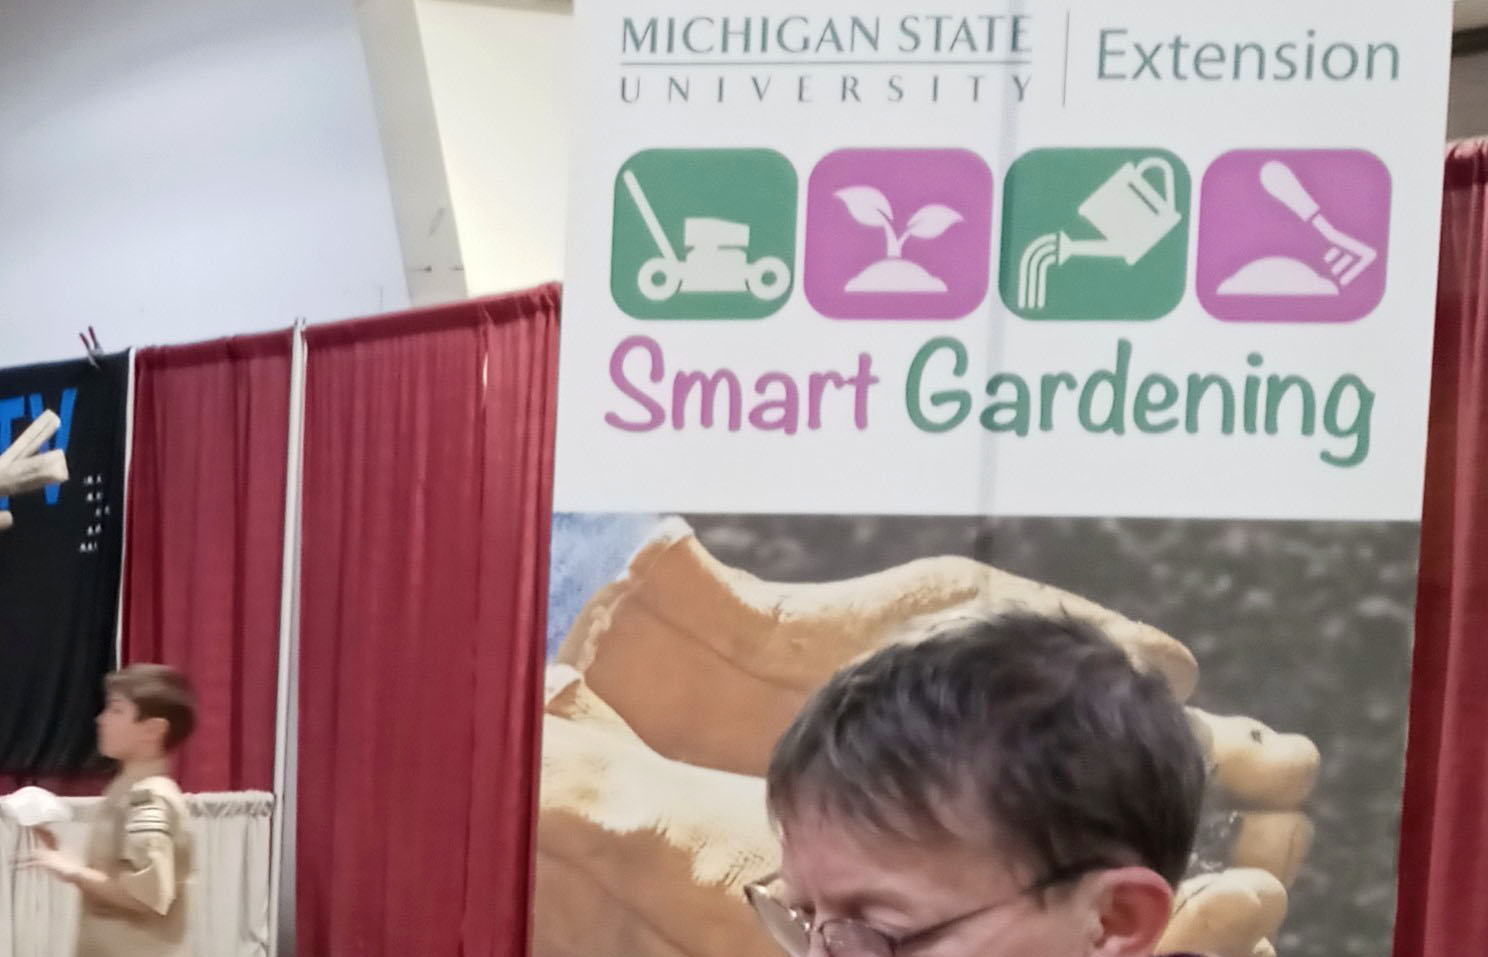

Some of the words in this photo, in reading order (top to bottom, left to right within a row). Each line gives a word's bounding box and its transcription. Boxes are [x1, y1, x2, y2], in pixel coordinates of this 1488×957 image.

[620, 16, 881, 55] MICHIGAN
[898, 16, 1032, 54] STATE
[1096, 29, 1401, 83] Extension
[619, 74, 1032, 104] UNIVERSITY
[603, 333, 880, 435] Smart
[905, 336, 1376, 468] Gardening
